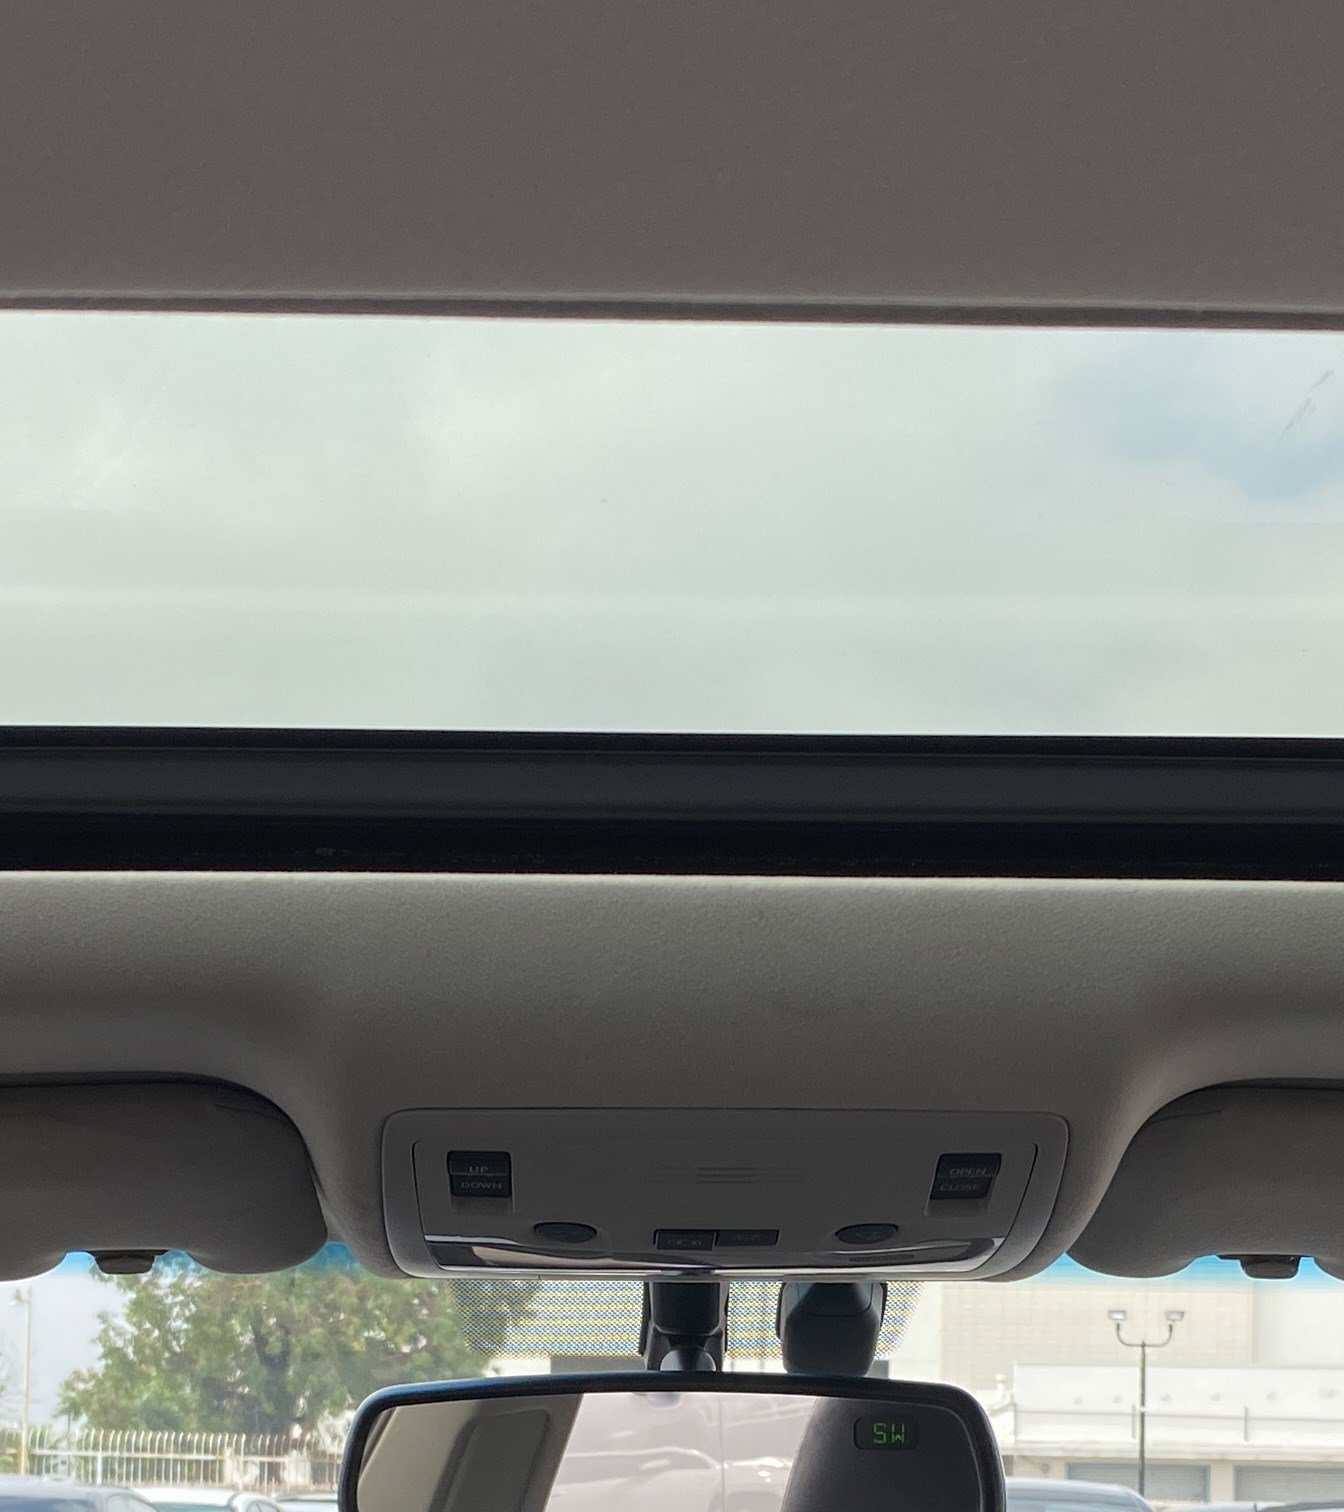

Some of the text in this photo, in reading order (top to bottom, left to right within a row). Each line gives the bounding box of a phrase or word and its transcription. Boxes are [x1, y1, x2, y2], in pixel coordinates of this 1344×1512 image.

[468, 1165, 489, 1174] UP
[460, 1181, 503, 1190] DOWN
[871, 1422, 906, 1445] SW
